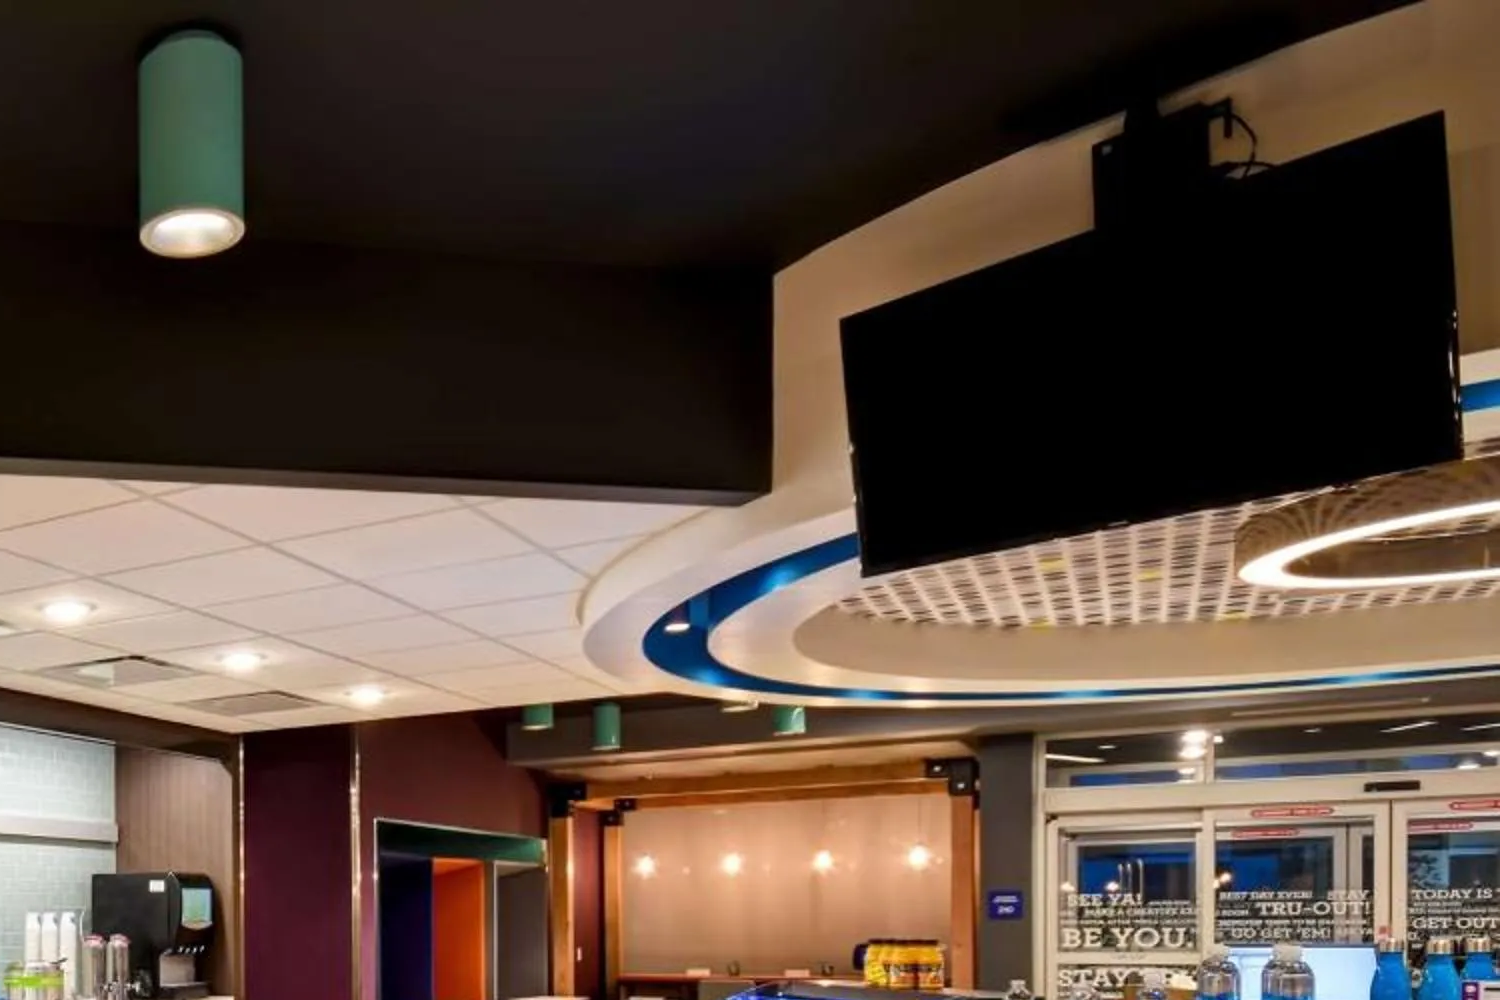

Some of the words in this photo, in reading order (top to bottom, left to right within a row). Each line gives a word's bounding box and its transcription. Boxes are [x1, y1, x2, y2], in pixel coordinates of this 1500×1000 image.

[1067, 893, 1103, 907] SEE
[1411, 888, 1473, 899] TODAY
[1476, 887, 1493, 899] IS
[1255, 901, 1371, 916] TRU-OUT!
[1411, 917, 1453, 929] GET
[1455, 916, 1498, 929] OUT
[1061, 927, 1102, 948] BE
[1109, 927, 1194, 948] YOU.
[1261, 928, 1292, 938] GET
[1058, 969, 1130, 987] STAY
